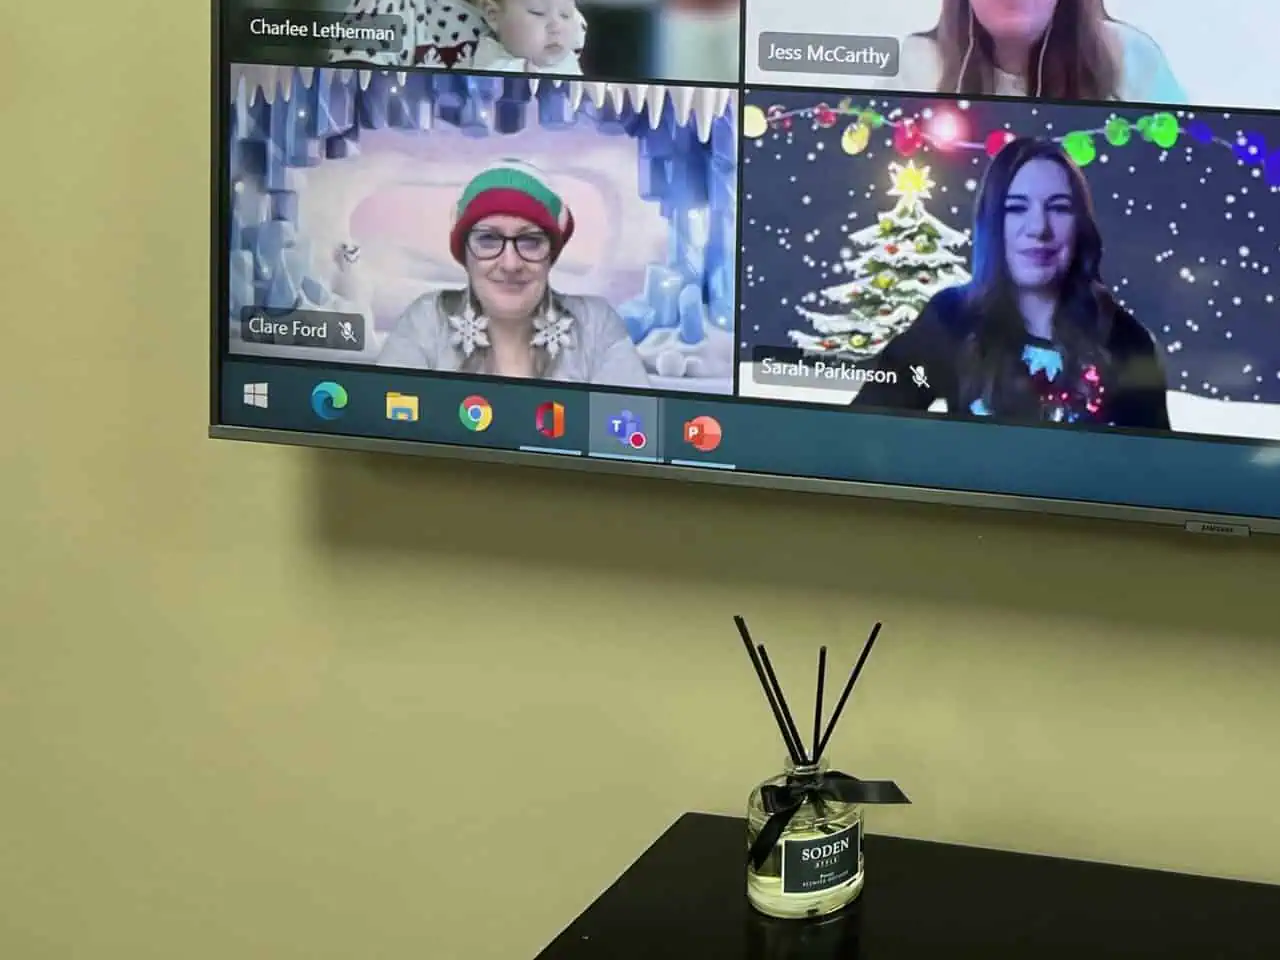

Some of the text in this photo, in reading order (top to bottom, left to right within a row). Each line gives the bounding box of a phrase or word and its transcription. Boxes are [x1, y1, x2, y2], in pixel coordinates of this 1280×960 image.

[249, 17, 395, 41] Charlee Letherman
[767, 43, 890, 69] Jess McCarthy
[248, 317, 328, 339] Clare Ford
[761, 357, 898, 384] Sarah Parkinson
[611, 419, 623, 433] T
[688, 425, 700, 439] P
[801, 837, 850, 861] SODEN
